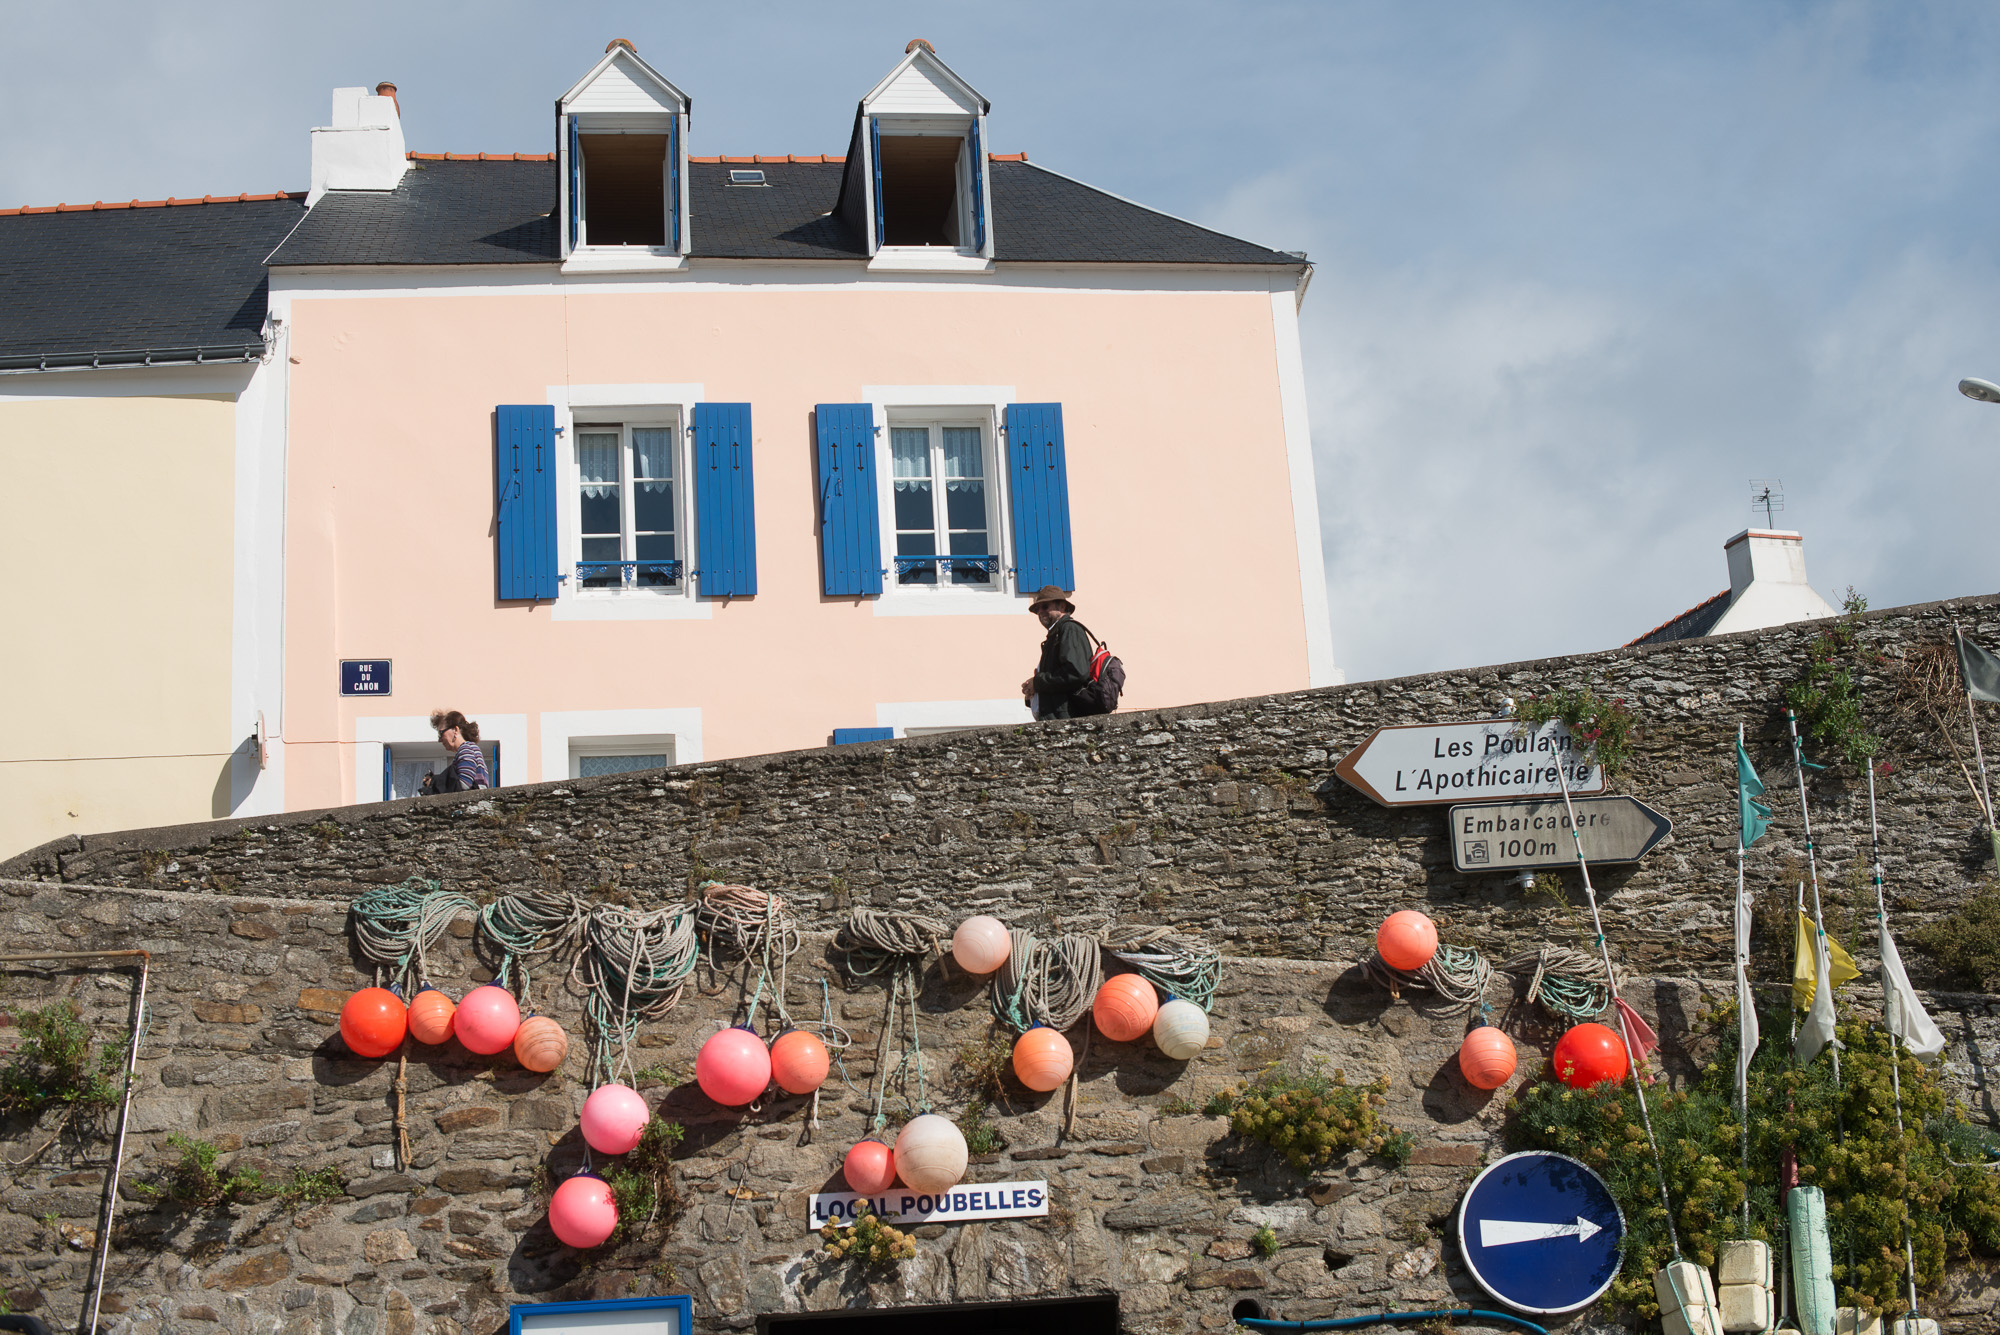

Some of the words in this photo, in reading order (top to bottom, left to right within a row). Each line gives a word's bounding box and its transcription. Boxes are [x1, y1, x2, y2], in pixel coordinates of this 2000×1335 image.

[359, 664, 373, 672] RUE
[361, 673, 371, 681] DU
[354, 682, 379, 691] CANON
[1434, 737, 1473, 758] Les
[1484, 730, 1577, 755] Poulain
[1464, 810, 1610, 834] Embarcadère
[1498, 838, 1557, 858] 100m
[815, 1197, 893, 1221] LOCAL
[901, 1188, 1042, 1216] POUBELLES
